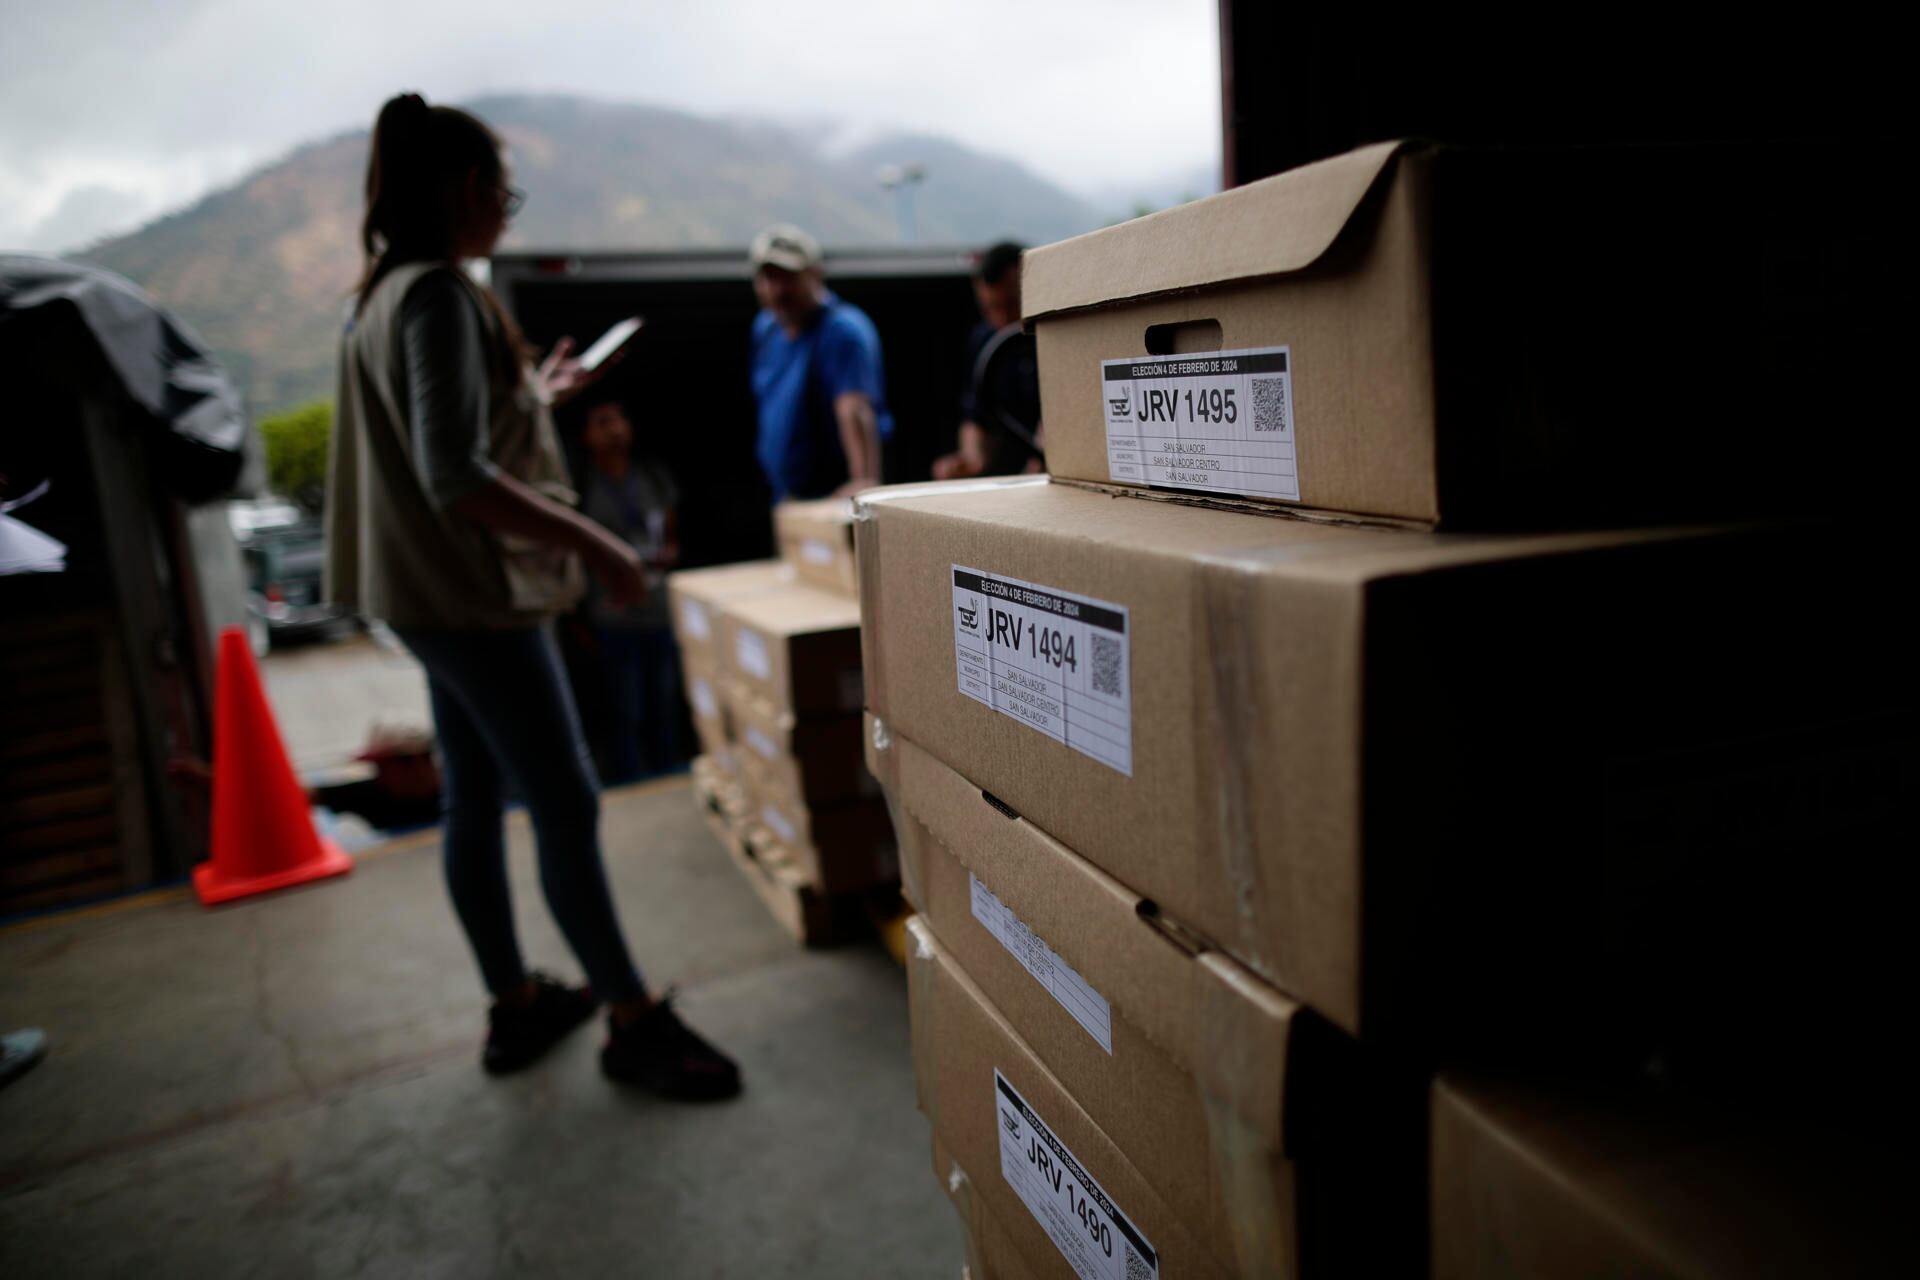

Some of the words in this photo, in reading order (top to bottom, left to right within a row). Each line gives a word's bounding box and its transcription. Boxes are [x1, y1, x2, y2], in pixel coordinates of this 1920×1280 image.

[1132, 362, 1163, 376] ELECCIÓN
[1168, 364, 1177, 374] DE
[1179, 362, 1209, 374] FEBRERO
[1210, 361, 1220, 372] DE
[1222, 360, 1238, 371] 2024
[1138, 389, 1179, 423] JRV
[1185, 388, 1238, 424] 1495
[1164, 442, 1175, 452] SAN
[1176, 443, 1206, 454] SALVADOR
[1154, 456, 1164, 465] SAN
[1165, 456, 1194, 469] SALVADOR
[1196, 459, 1220, 471] CENTRO
[1166, 471, 1176, 480] SAN
[1178, 472, 1208, 484] SALVADOR
[981, 580, 1009, 597] ELECCIÓN
[1013, 588, 1022, 600] DE
[1022, 591, 1052, 609] FEBRERO
[1053, 599, 1062, 612] DE
[986, 608, 1022, 651] JRV
[1028, 623, 1077, 673] 1494
[1008, 670, 1017, 681] SAN
[1019, 674, 1046, 694] SALVADOR
[998, 680, 1007, 692] SAN
[1009, 684, 1035, 705] SALVADOR
[1037, 697, 1060, 716] CENTRO
[1009, 700, 1019, 712] SAN
[1020, 704, 1048, 727] SALVADOR
[1053, 1141, 1062, 1156] DE
[1062, 1151, 1090, 1189] FEBRERO
[1090, 1184, 1099, 1200] DE
[1027, 1137, 1062, 1194] JRV
[1067, 1183, 1112, 1258] 1490
